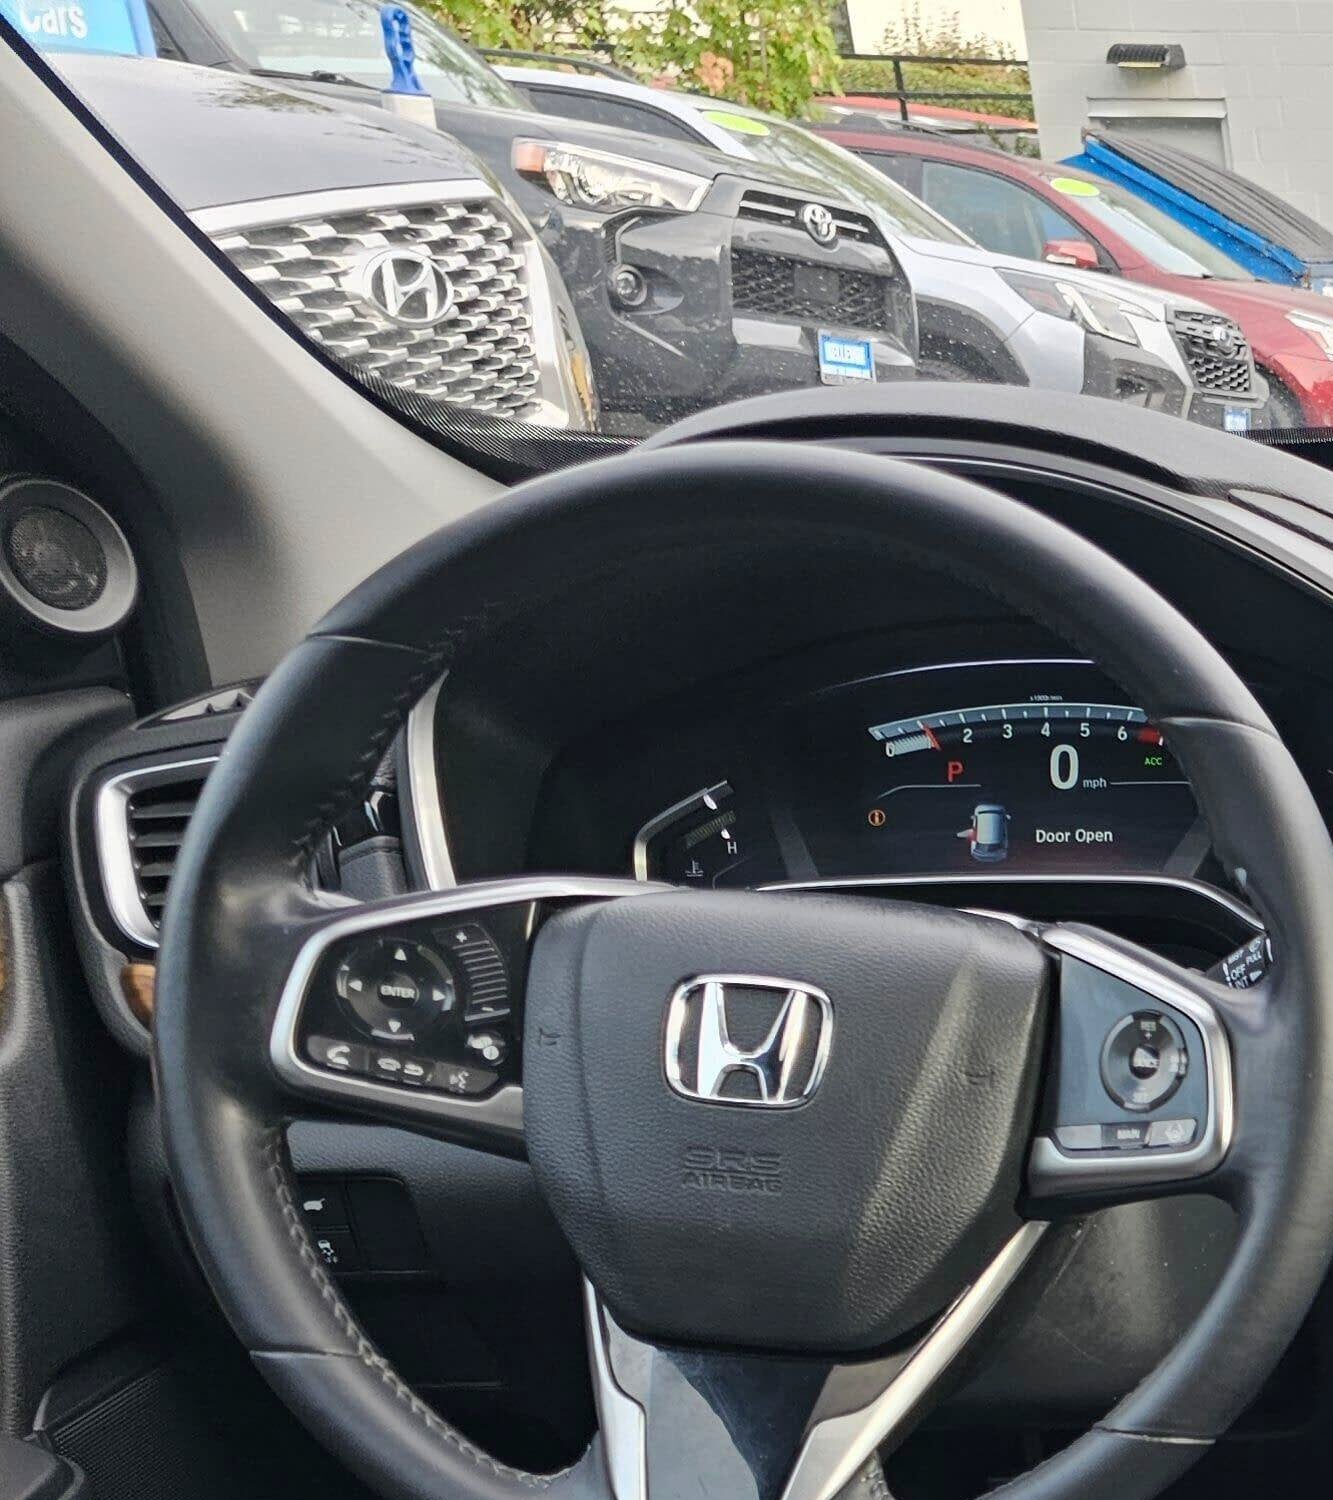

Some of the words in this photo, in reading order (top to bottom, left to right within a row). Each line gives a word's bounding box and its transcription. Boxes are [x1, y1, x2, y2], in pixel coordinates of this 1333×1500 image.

[963, 729, 973, 743] 2
[1002, 723, 1013, 739] 3
[1041, 722, 1051, 737] 4
[1080, 722, 1091, 738] 5
[1117, 725, 1128, 741] 6
[1050, 743, 1079, 790] 0
[1082, 776, 1107, 790] mph
[1144, 756, 1163, 766] ACC
[947, 761, 963, 782] P
[1035, 829, 1070, 843] Door
[1075, 828, 1113, 844] Open
[727, 841, 737, 854] H
[1231, 963, 1246, 980] OFF
[380, 985, 416, 999] ENTER
